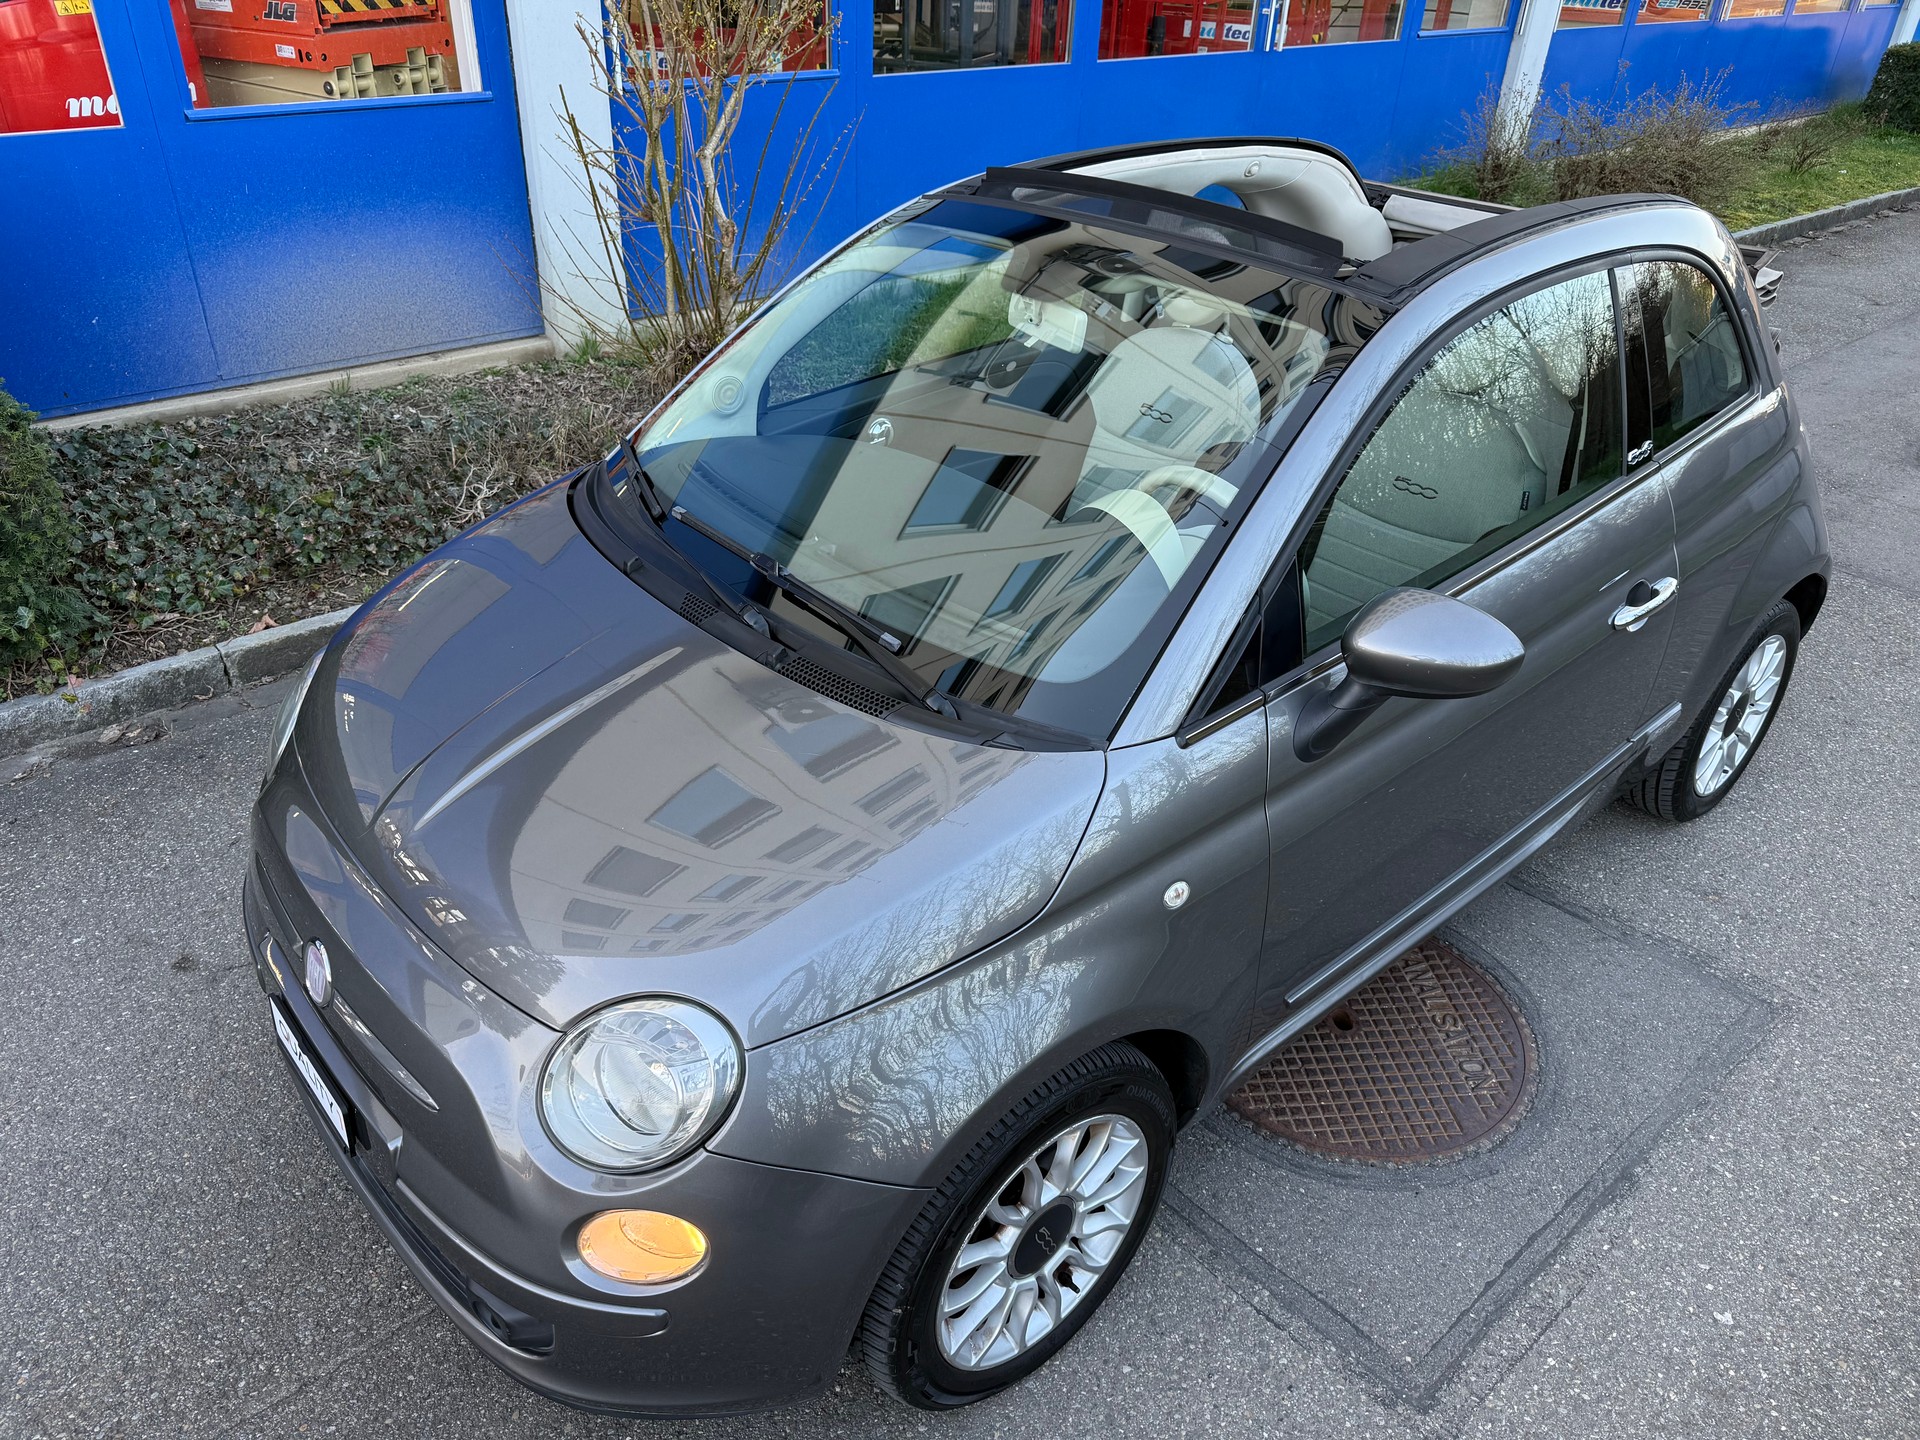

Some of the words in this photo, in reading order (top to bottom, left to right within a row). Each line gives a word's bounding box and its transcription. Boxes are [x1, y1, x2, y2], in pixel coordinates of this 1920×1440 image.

[263, 1, 297, 22] JLG
[1138, 402, 1173, 424] 500
[1392, 475, 1439, 500] 500
[1402, 948, 1500, 1095] ANALISATION
[278, 1019, 334, 1114] QUALITY
[1126, 1084, 1169, 1119] QUARTARIS
[1034, 1226, 1057, 1255] 500
